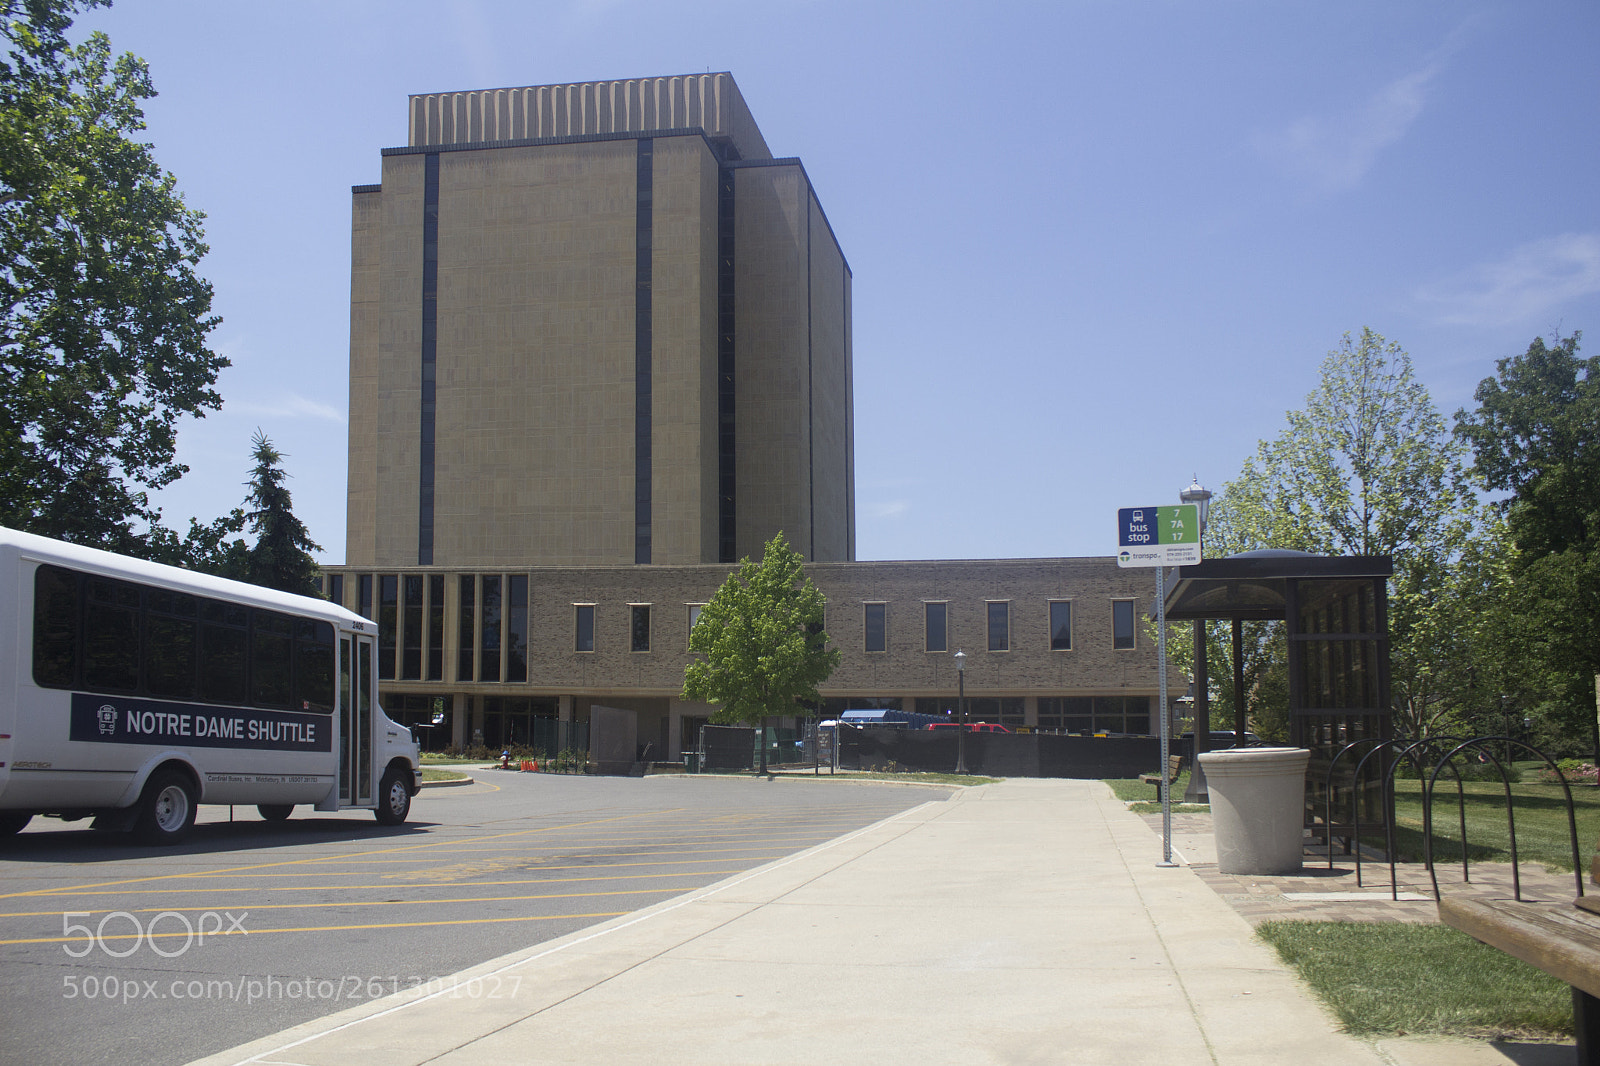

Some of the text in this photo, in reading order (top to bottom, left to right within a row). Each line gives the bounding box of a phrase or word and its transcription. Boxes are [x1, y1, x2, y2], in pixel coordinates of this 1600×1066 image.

[1173, 509, 1180, 517] 7
[1129, 522, 1148, 533] bus
[1170, 520, 1184, 529] 7A
[1127, 533, 1150, 544] stop
[1172, 532, 1184, 541] 17
[126, 710, 316, 743] NOTRE DAME SHUTTLE
